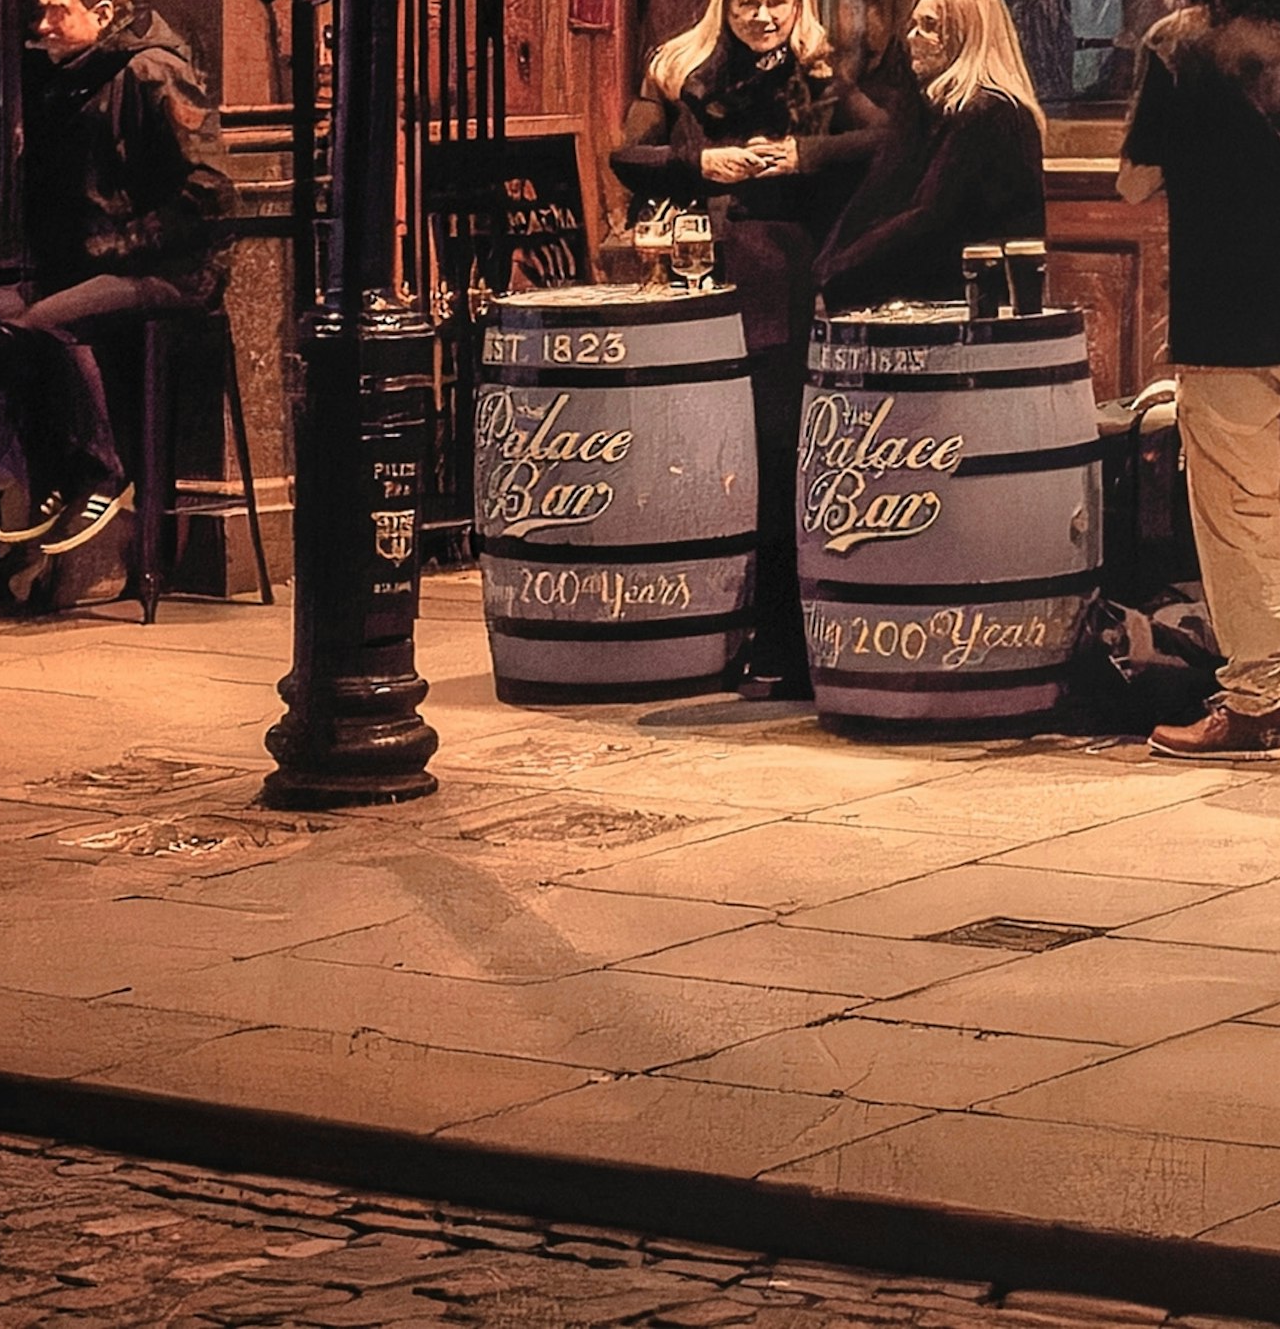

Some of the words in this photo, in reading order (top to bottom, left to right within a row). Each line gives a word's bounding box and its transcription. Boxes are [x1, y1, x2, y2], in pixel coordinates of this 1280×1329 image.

[543, 331, 627, 364] 1823
[477, 390, 636, 464] Palace
[802, 392, 964, 473] Palace
[484, 459, 615, 538] Bar
[804, 467, 942, 553] Bar
[519, 568, 581, 605] 200
[584, 569, 692, 619] Years
[850, 616, 928, 661] 200
